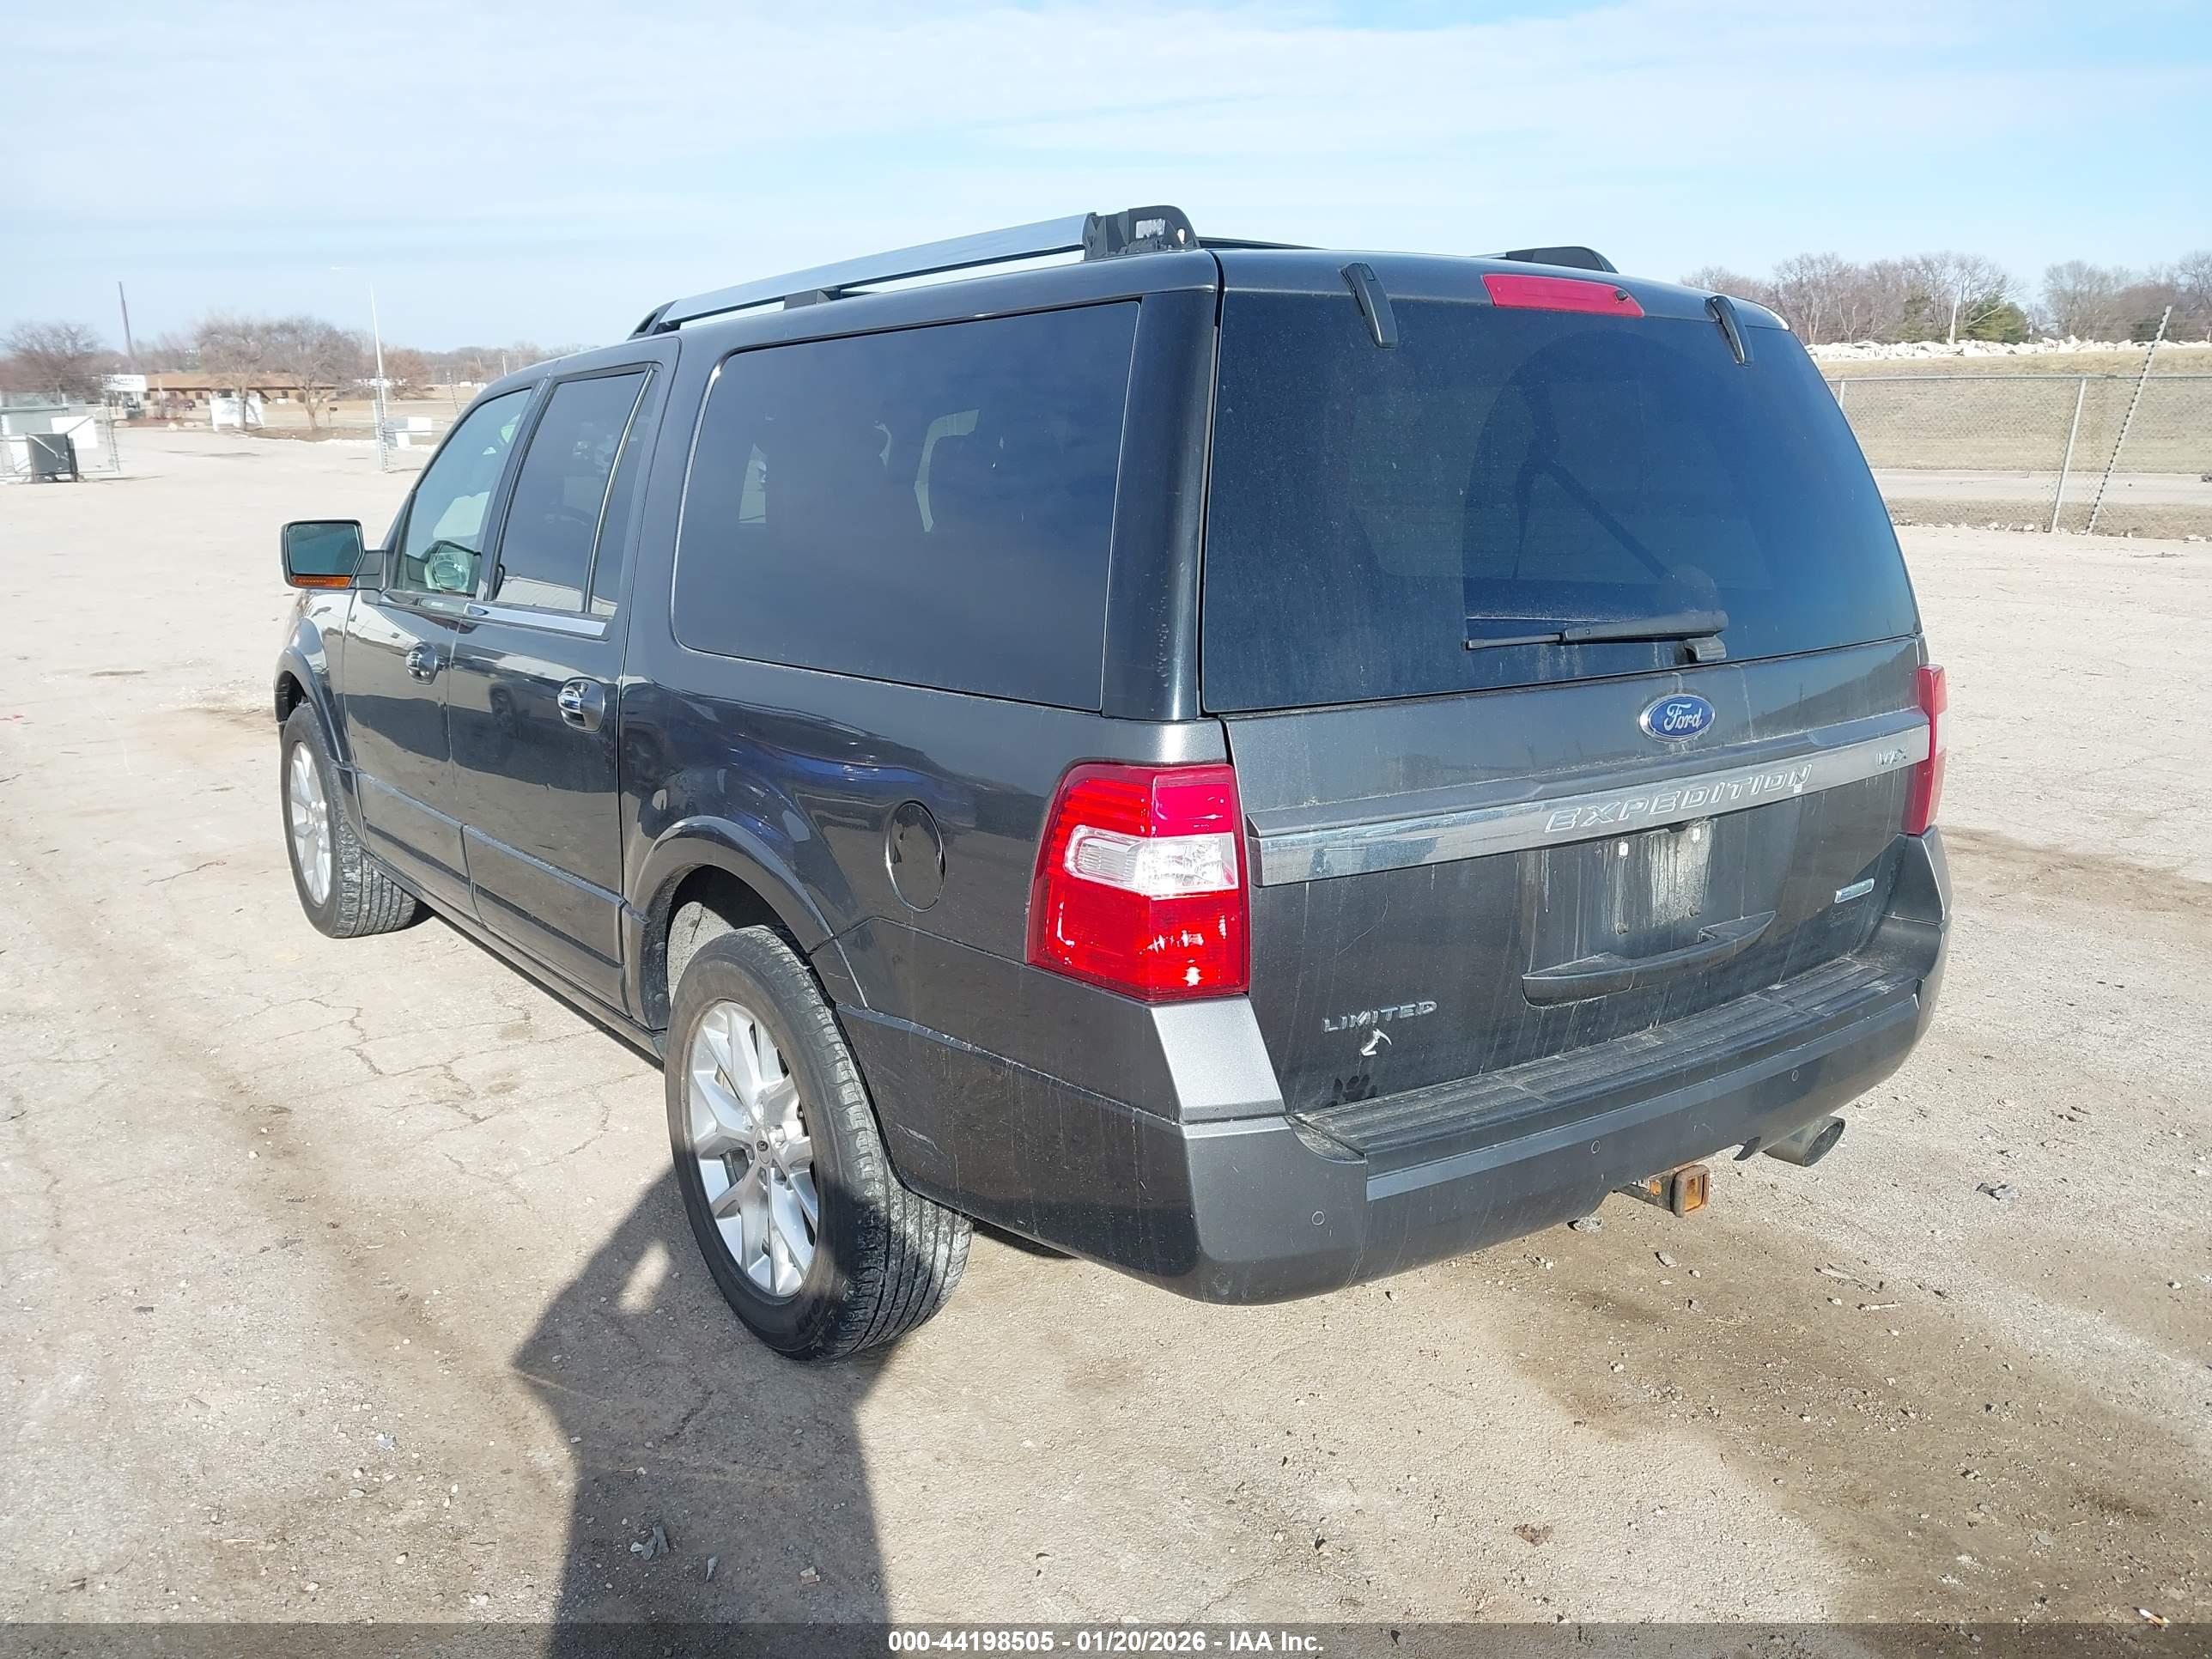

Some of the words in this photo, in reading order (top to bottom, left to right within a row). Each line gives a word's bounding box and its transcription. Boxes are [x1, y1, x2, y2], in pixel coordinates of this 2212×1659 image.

[1664, 703, 1704, 730] Ford
[1545, 763, 1813, 833] EXPEDITION
[1322, 1000, 1437, 1033] LIMITED
